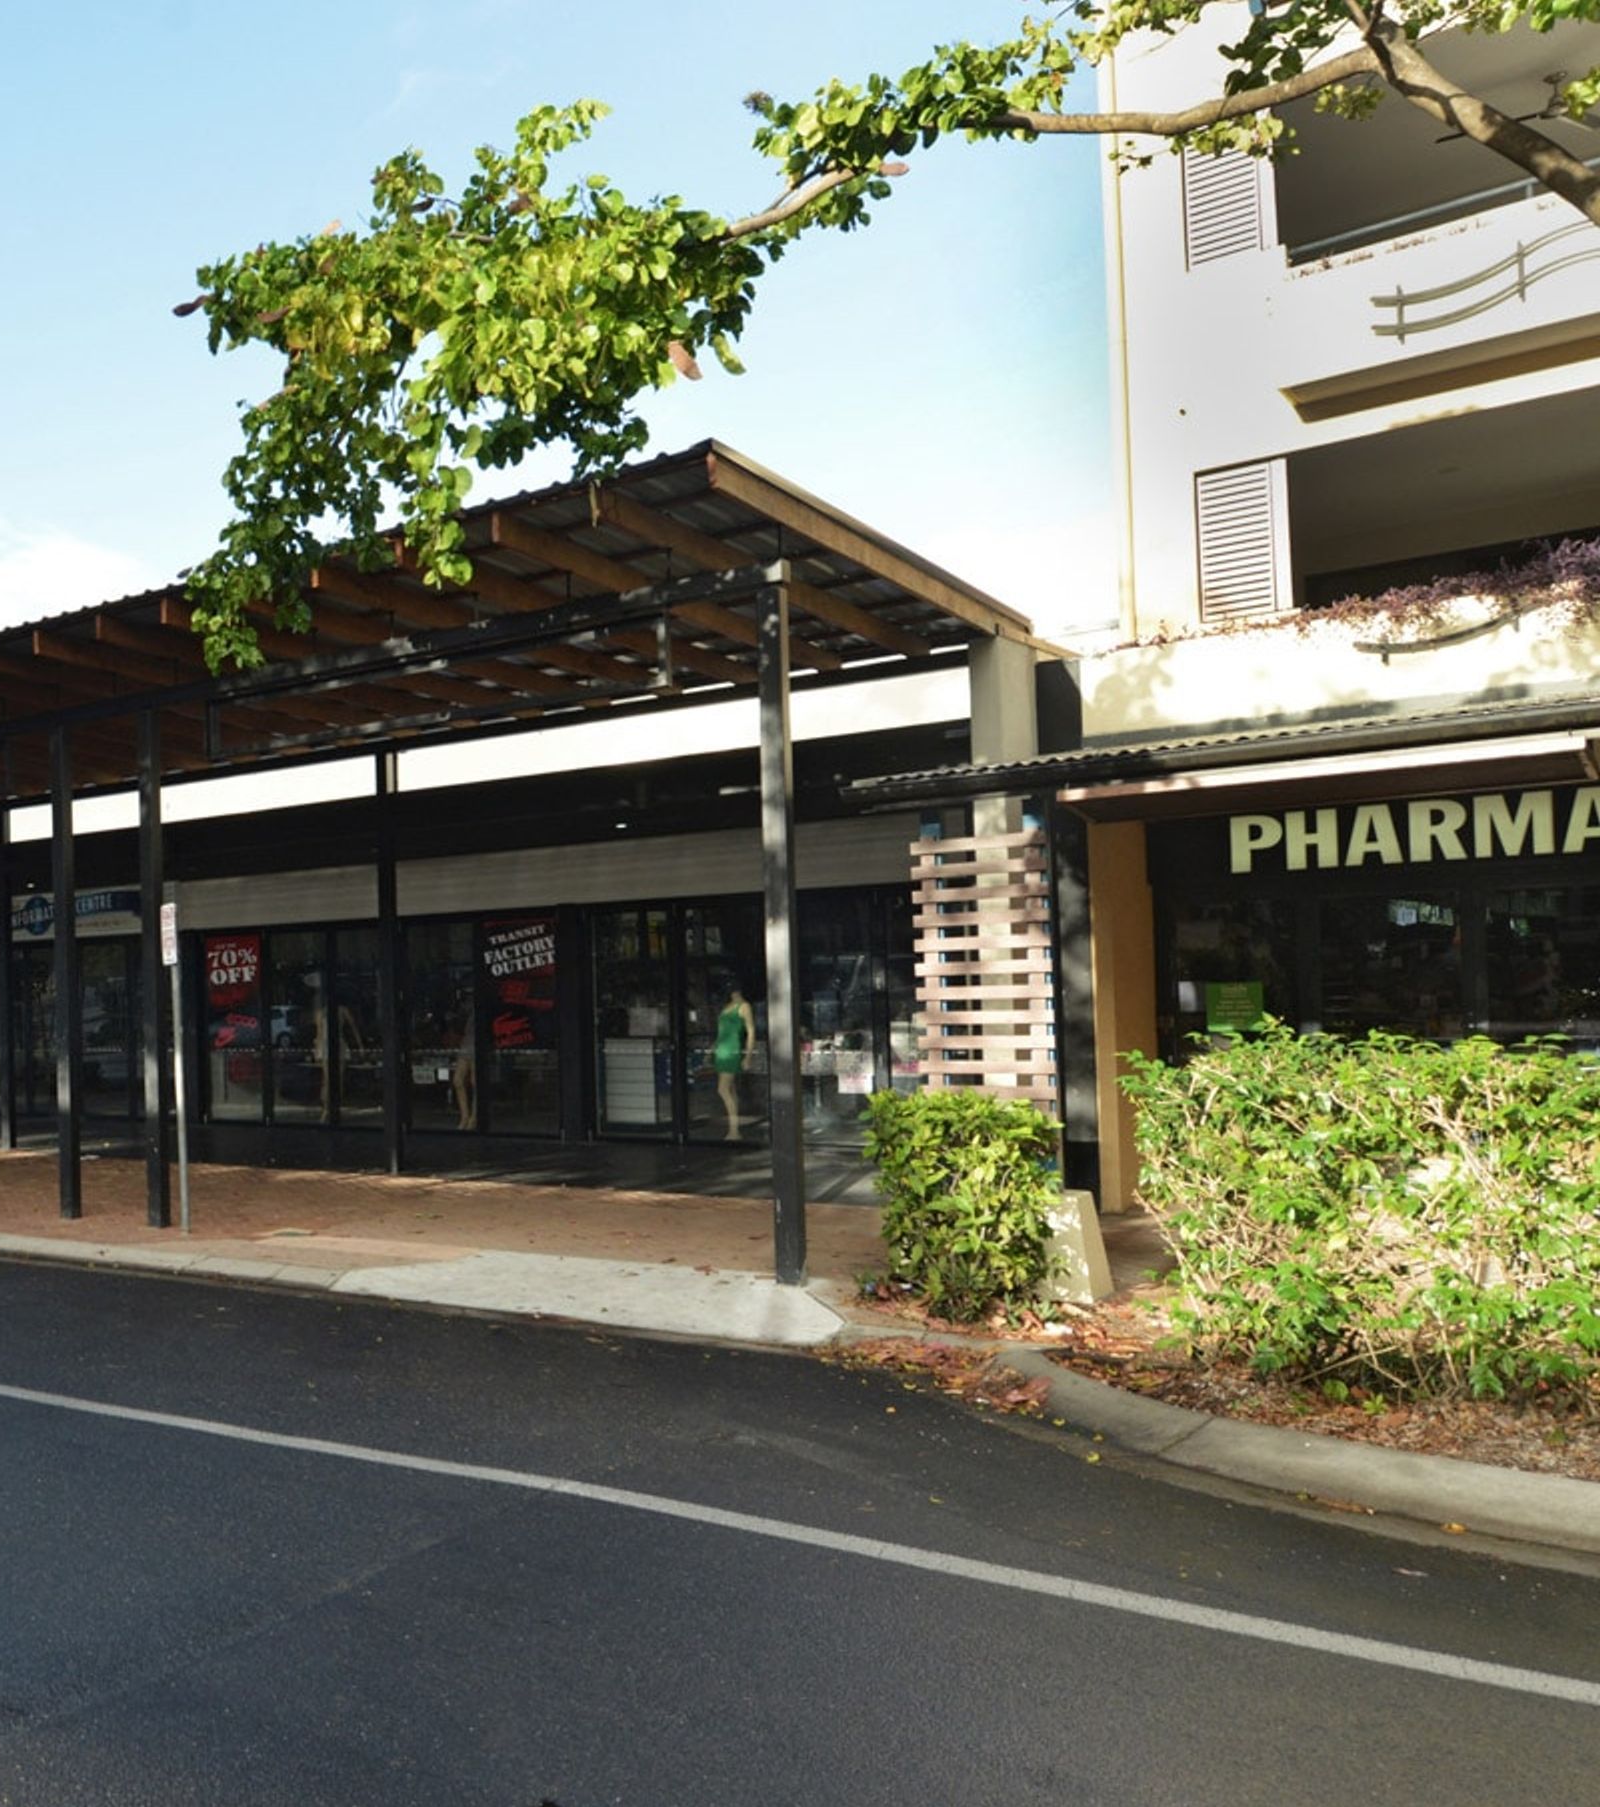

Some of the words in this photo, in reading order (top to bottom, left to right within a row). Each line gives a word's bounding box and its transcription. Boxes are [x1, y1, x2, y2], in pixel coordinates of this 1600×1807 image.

[1229, 787, 1600, 874] PHARMA
[75, 894, 113, 917] CENTRE
[490, 924, 545, 944] TRANSIT
[208, 949, 257, 969] 70%
[484, 934, 555, 965] FACTORY
[491, 950, 555, 977] OUTLET
[210, 966, 257, 985] OFF
